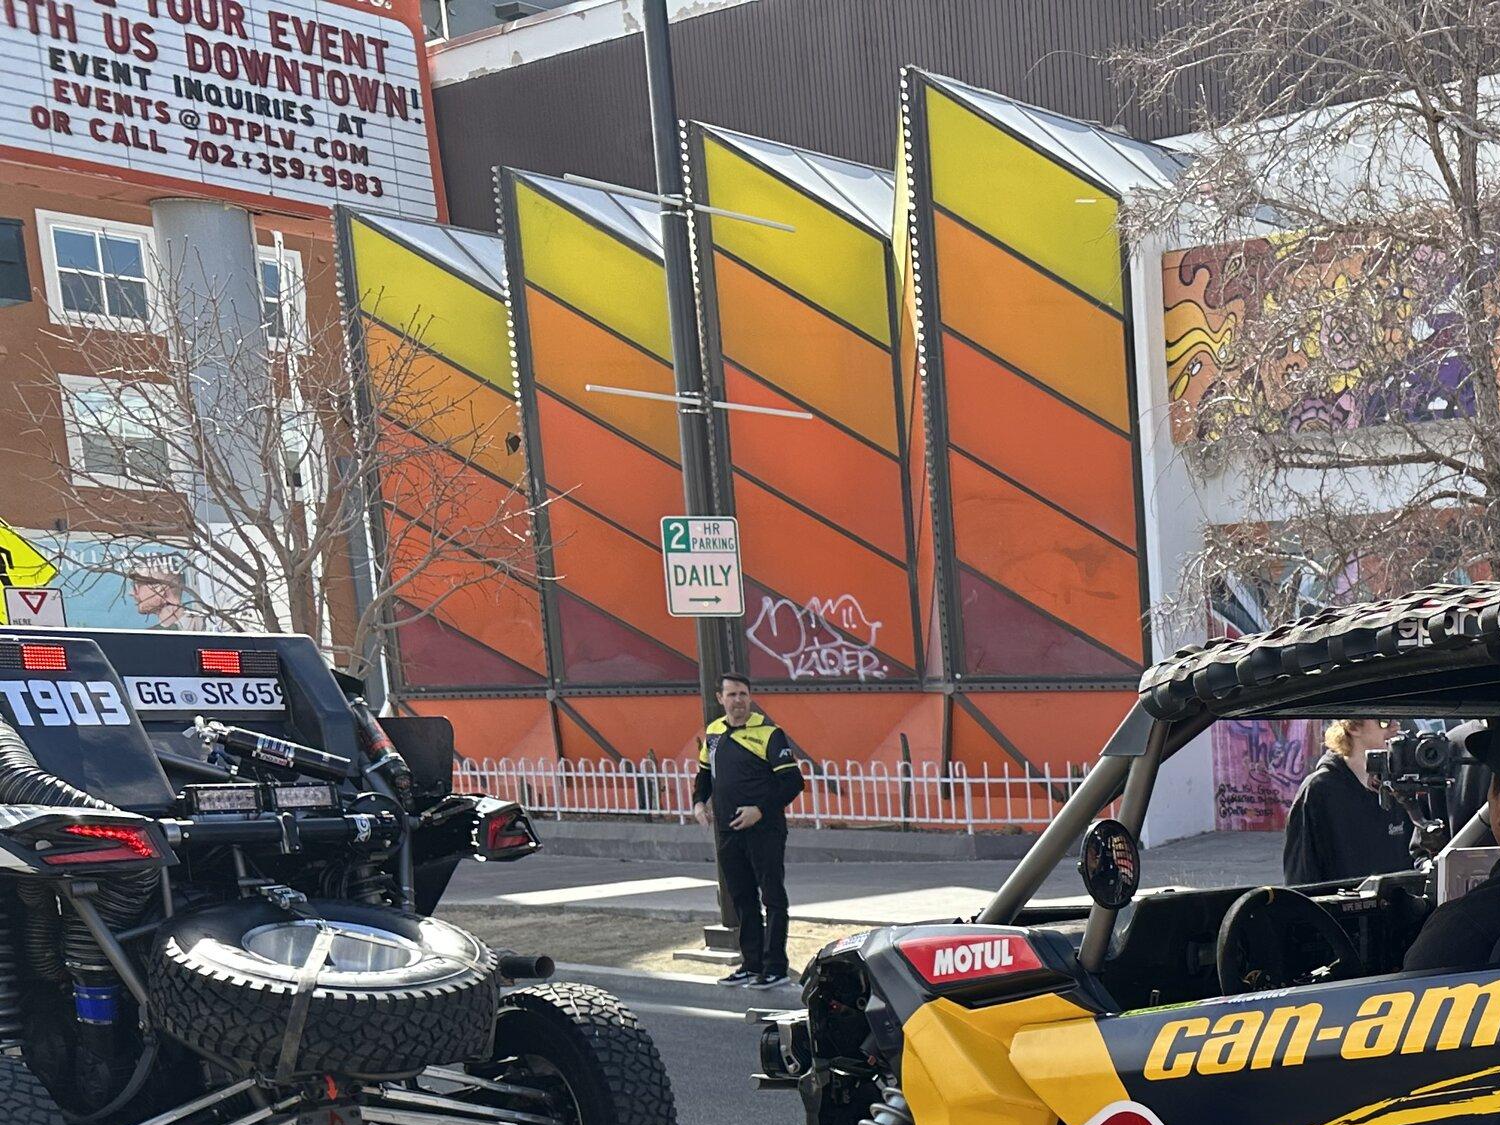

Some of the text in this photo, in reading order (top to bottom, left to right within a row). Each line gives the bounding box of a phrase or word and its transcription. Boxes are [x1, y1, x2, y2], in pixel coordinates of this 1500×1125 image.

[269, 11, 389, 74] EVENT
[102, 12, 158, 62] US
[185, 33, 422, 124] DOWNTOWN!
[49, 47, 366, 138] EVENT INQUIRIES AT
[31, 105, 72, 135] OR
[89, 118, 167, 154] CALL
[669, 522, 686, 549] 2
[692, 538, 734, 549] PARKING
[704, 523, 720, 534] HR
[674, 565, 731, 587] DAILY
[0, 680, 131, 726] T903
[135, 682, 177, 704] GG
[203, 683, 235, 705] SR
[933, 938, 1014, 977] MOTUL
